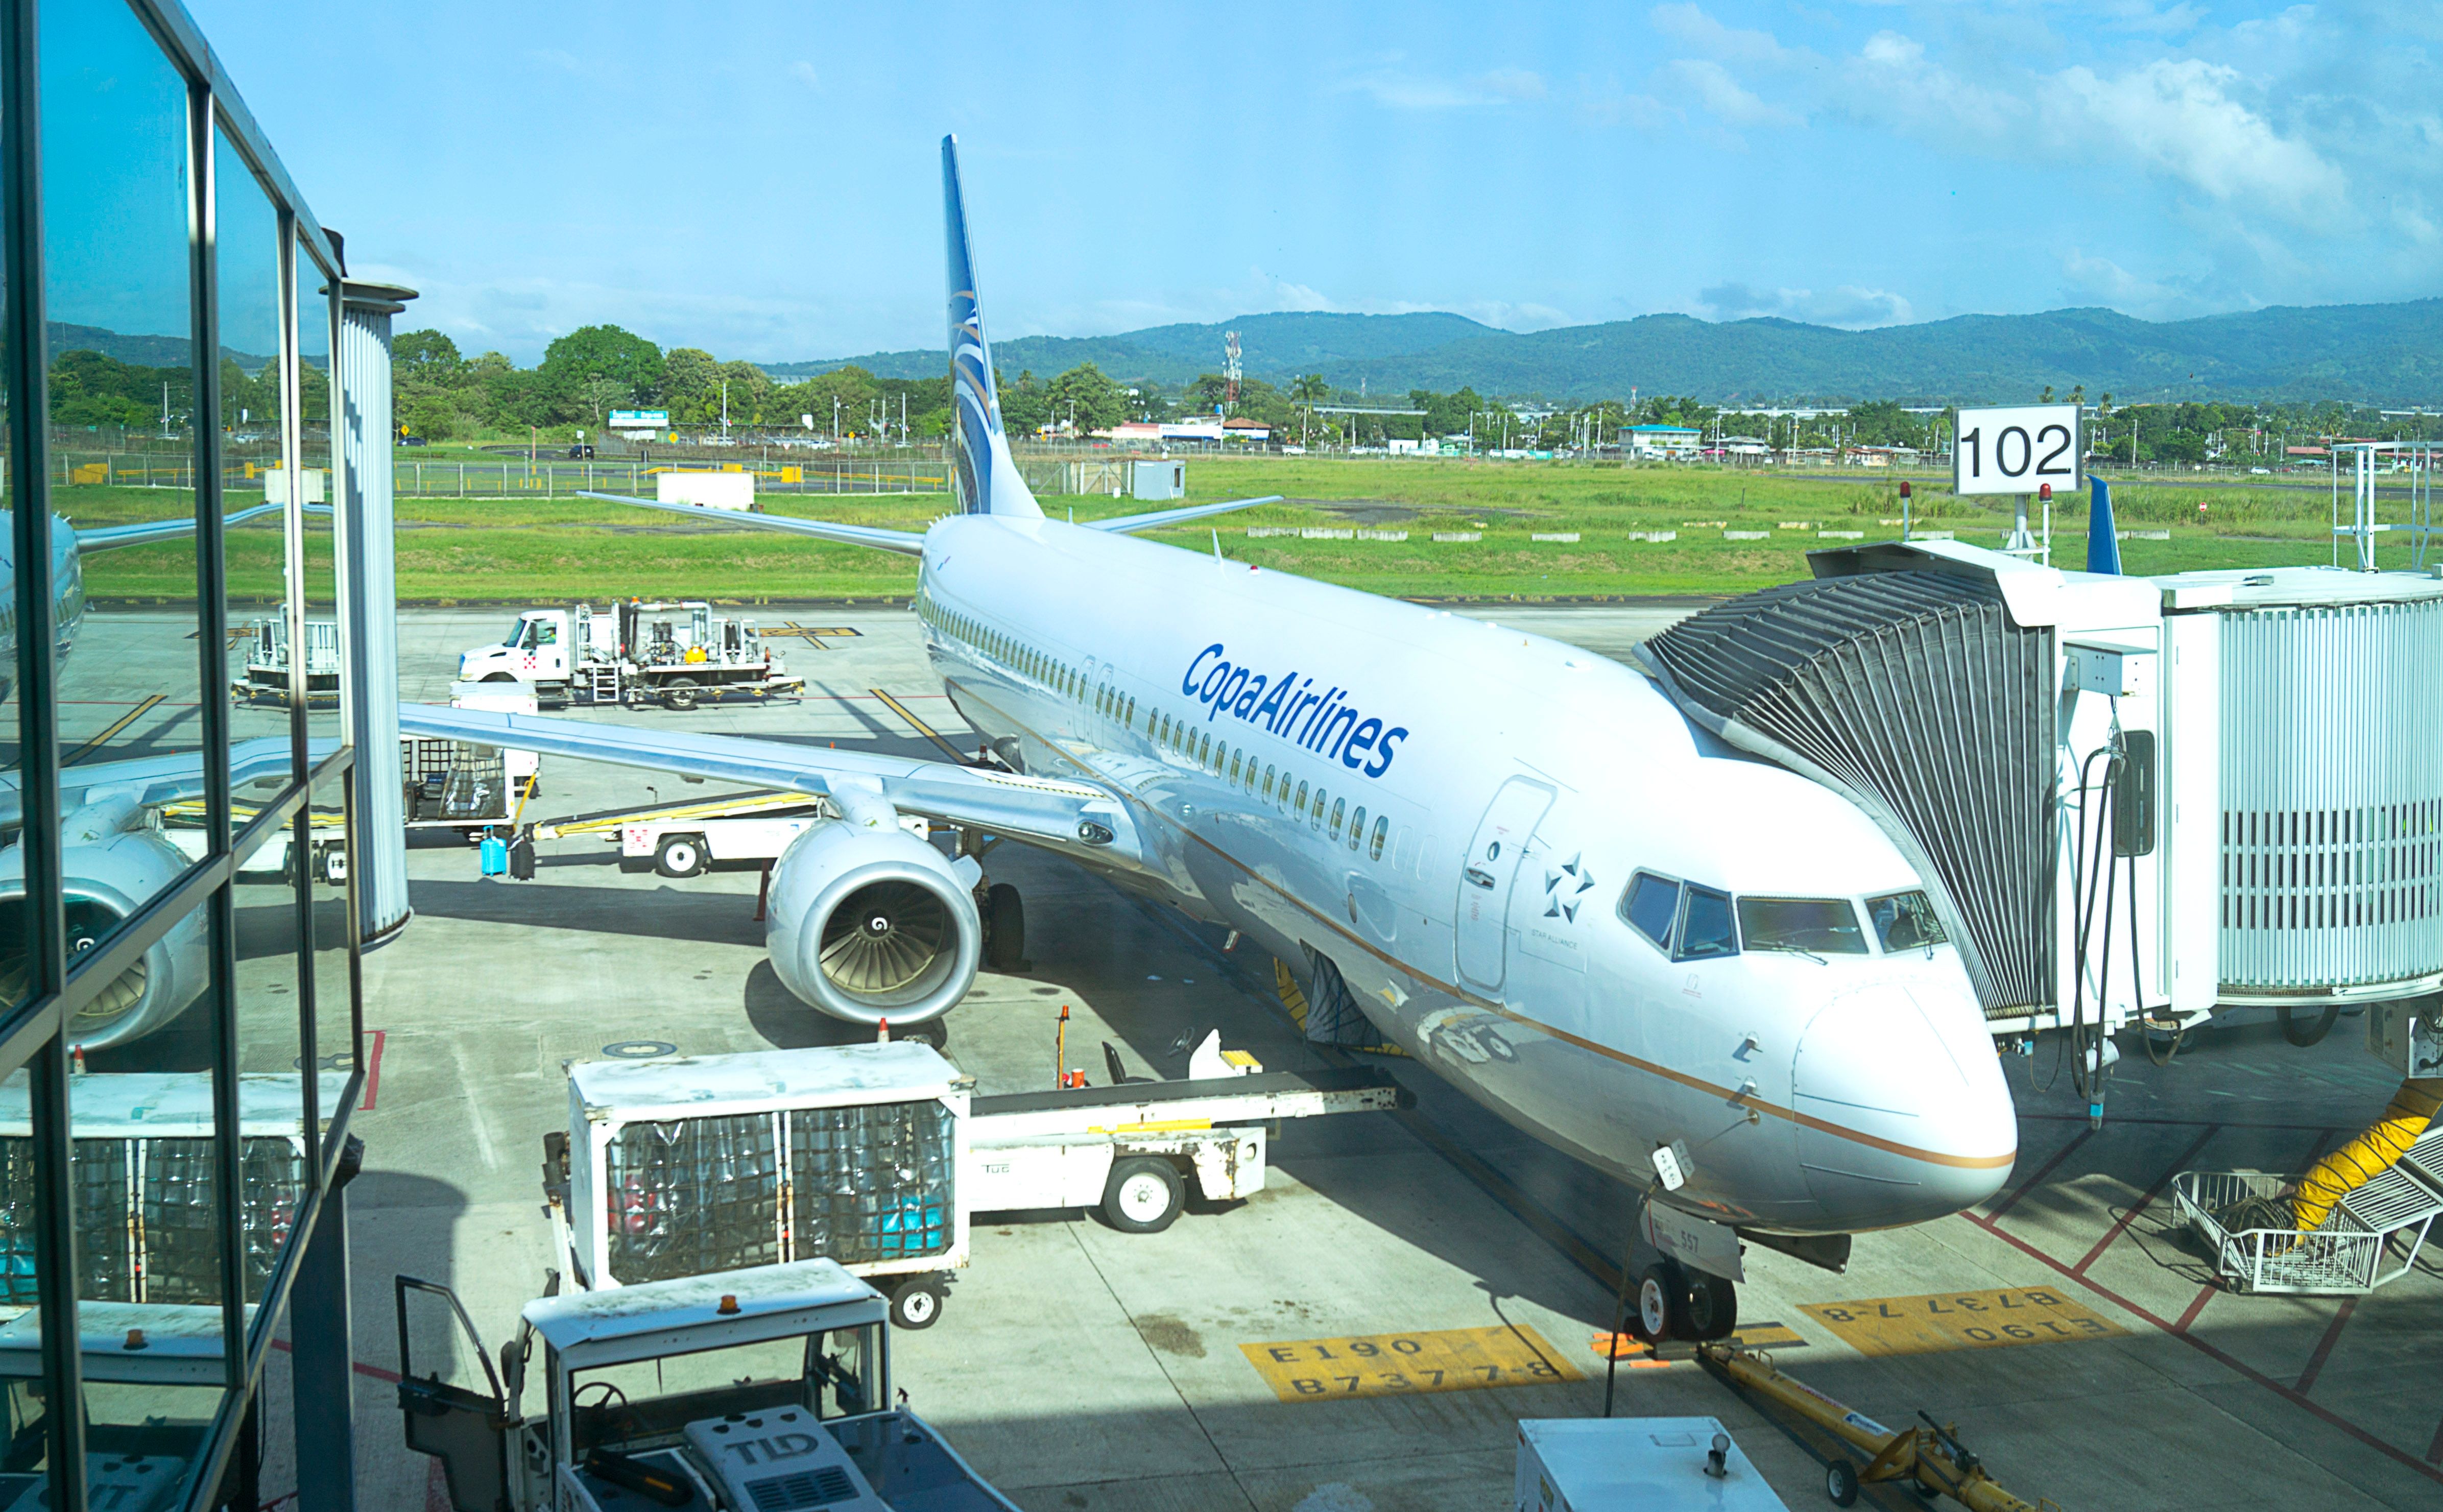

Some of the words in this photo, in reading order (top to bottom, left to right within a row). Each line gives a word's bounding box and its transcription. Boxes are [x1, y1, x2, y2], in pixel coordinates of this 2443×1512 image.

[1961, 424, 2071, 478] 102
[1182, 643, 1409, 779] CopaAirlines
[1531, 928, 1547, 939] STAR
[1547, 934, 1578, 950] ALLIANCE
[1681, 1230, 1699, 1254] 557
[1964, 1318, 2109, 1341] E190
[1268, 1339, 1423, 1363] E190
[724, 1433, 820, 1466] TLD
